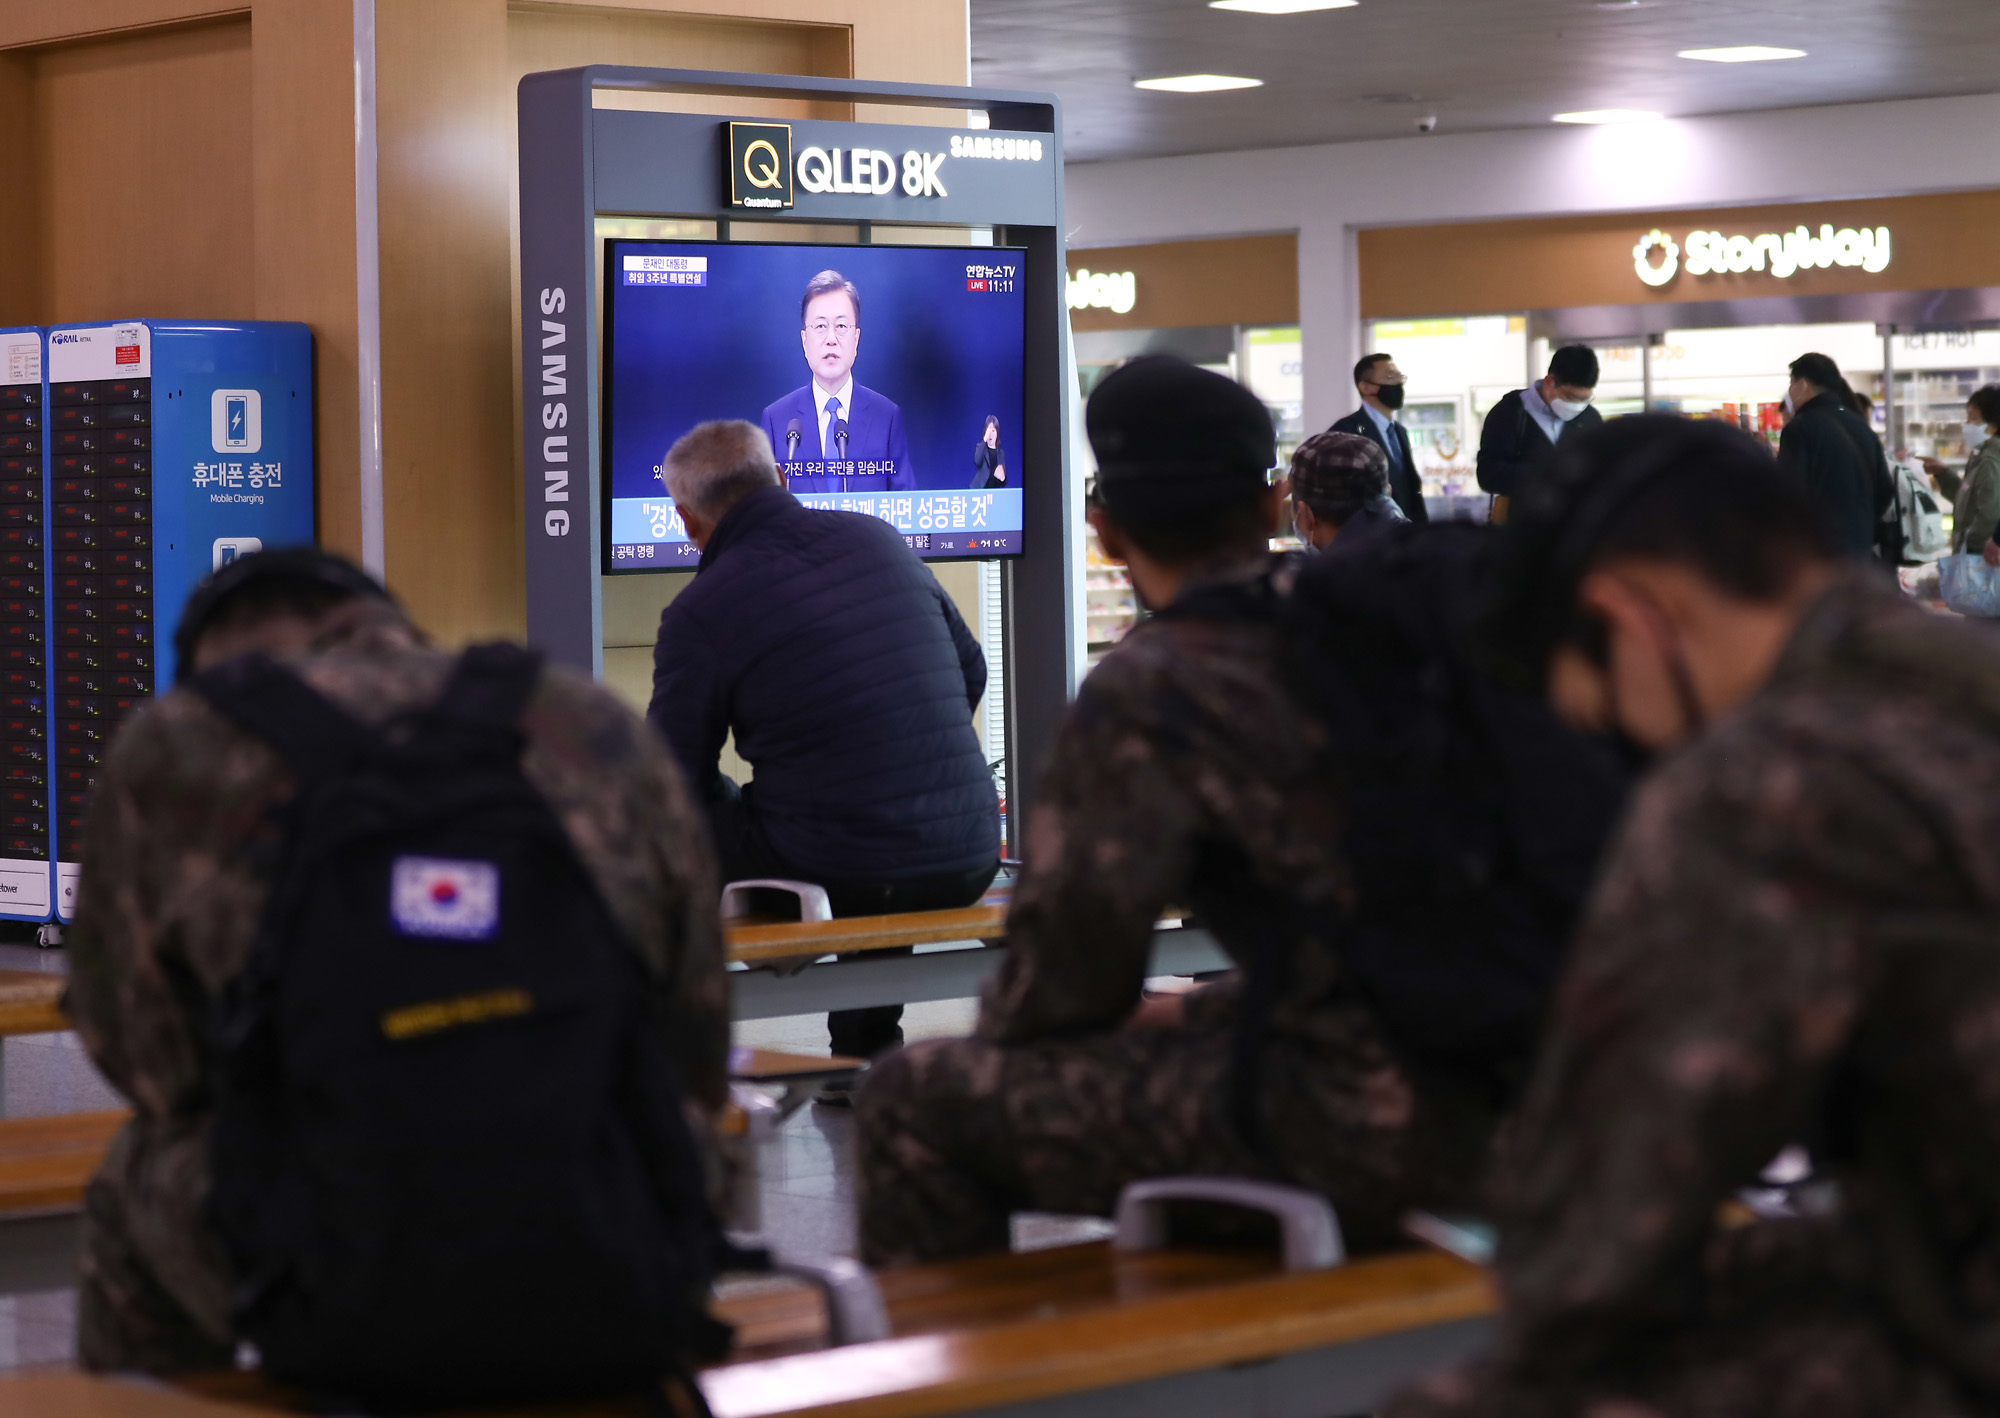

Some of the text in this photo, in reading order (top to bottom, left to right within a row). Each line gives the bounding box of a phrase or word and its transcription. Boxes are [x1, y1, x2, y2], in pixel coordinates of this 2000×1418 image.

[950, 135, 1043, 162] SAMSUNG
[743, 139, 783, 189] Q
[797, 147, 948, 197] QLED 8K
[743, 196, 782, 208] Quantum
[643, 257, 688, 270] 문재인 대통령
[965, 265, 1016, 278] 연합뉴스TV
[628, 272, 702, 285] 취임 3주년 특별연설
[970, 279, 1013, 293] LIVE 11:11
[540, 287, 570, 537] SAMSUNG
[192, 462, 282, 489] 휴대폰 충전
[784, 460, 897, 477] 가진 우리 국민을 믿습니다.
[210, 494, 264, 504] Mobile Charging
[916, 496, 968, 529] 성공할
[617, 545, 635, 559] 공탁
[637, 544, 655, 558] 명령
